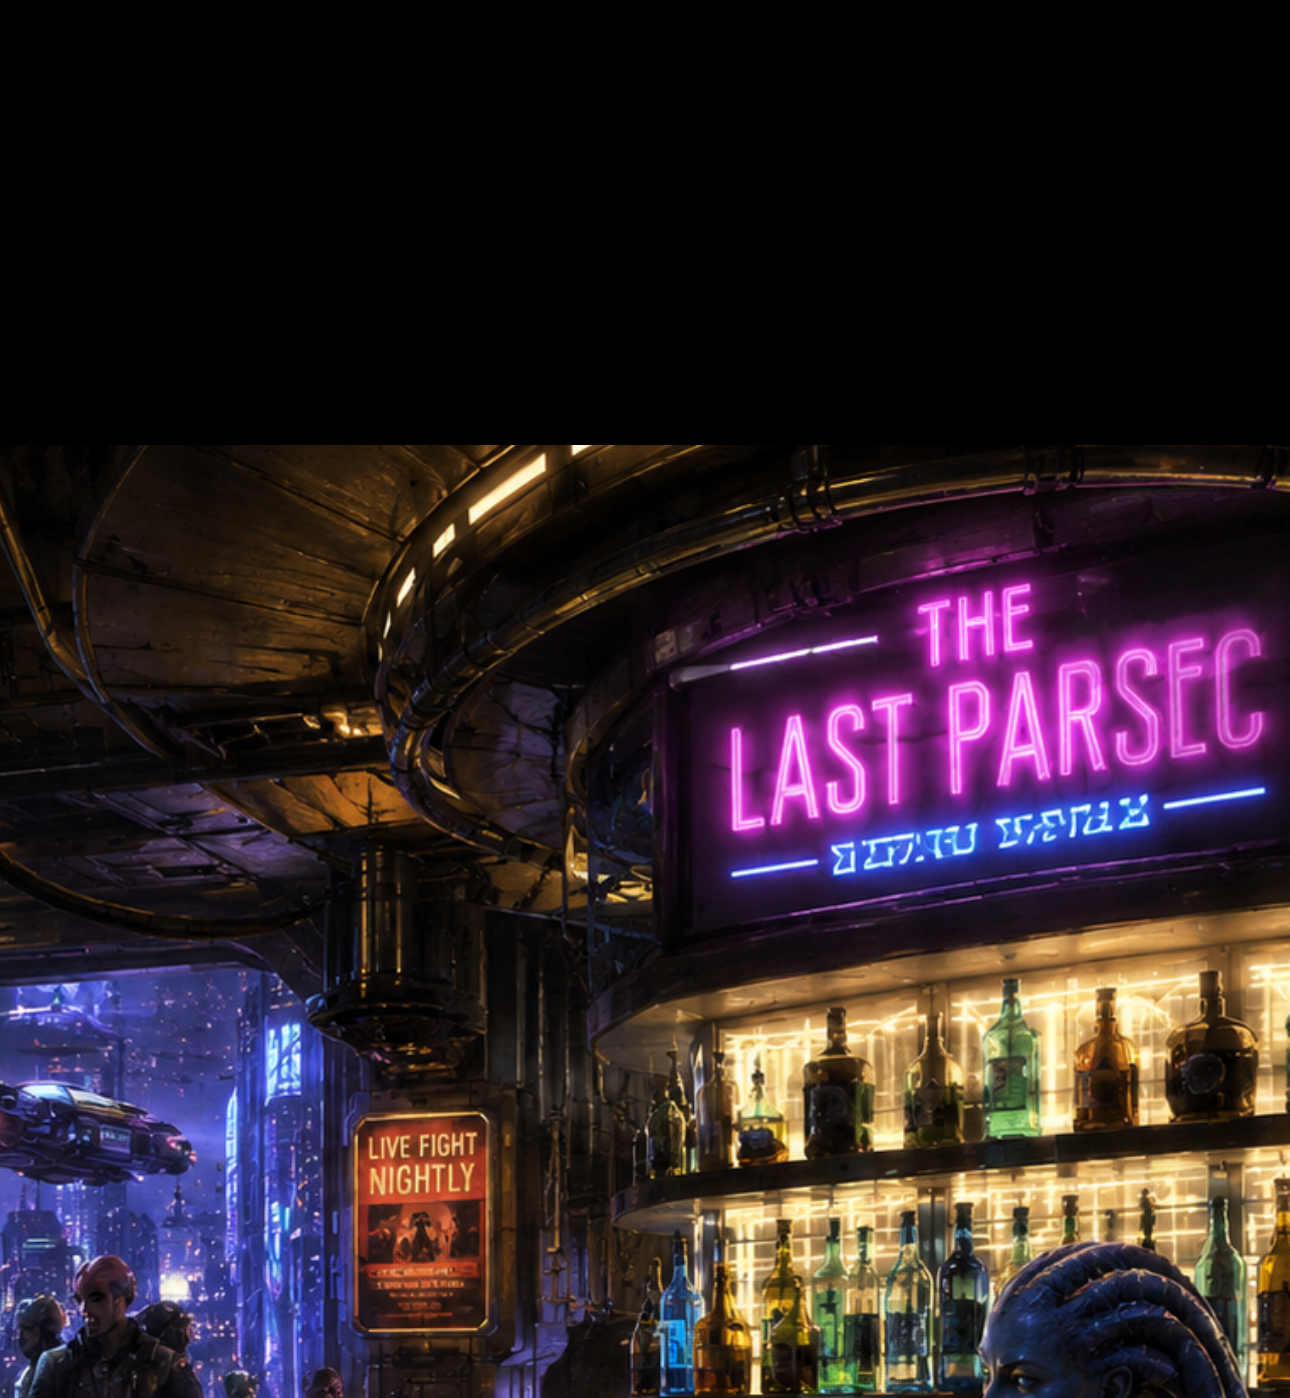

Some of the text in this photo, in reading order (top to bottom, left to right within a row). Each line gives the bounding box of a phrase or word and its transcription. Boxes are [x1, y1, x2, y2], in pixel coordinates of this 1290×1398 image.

[917, 582, 1034, 667] THE
[730, 628, 1264, 832] LAST PARSEC
[368, 1131, 478, 1160] LIVE FIGHT
[369, 1162, 475, 1196] NIGHTLY
